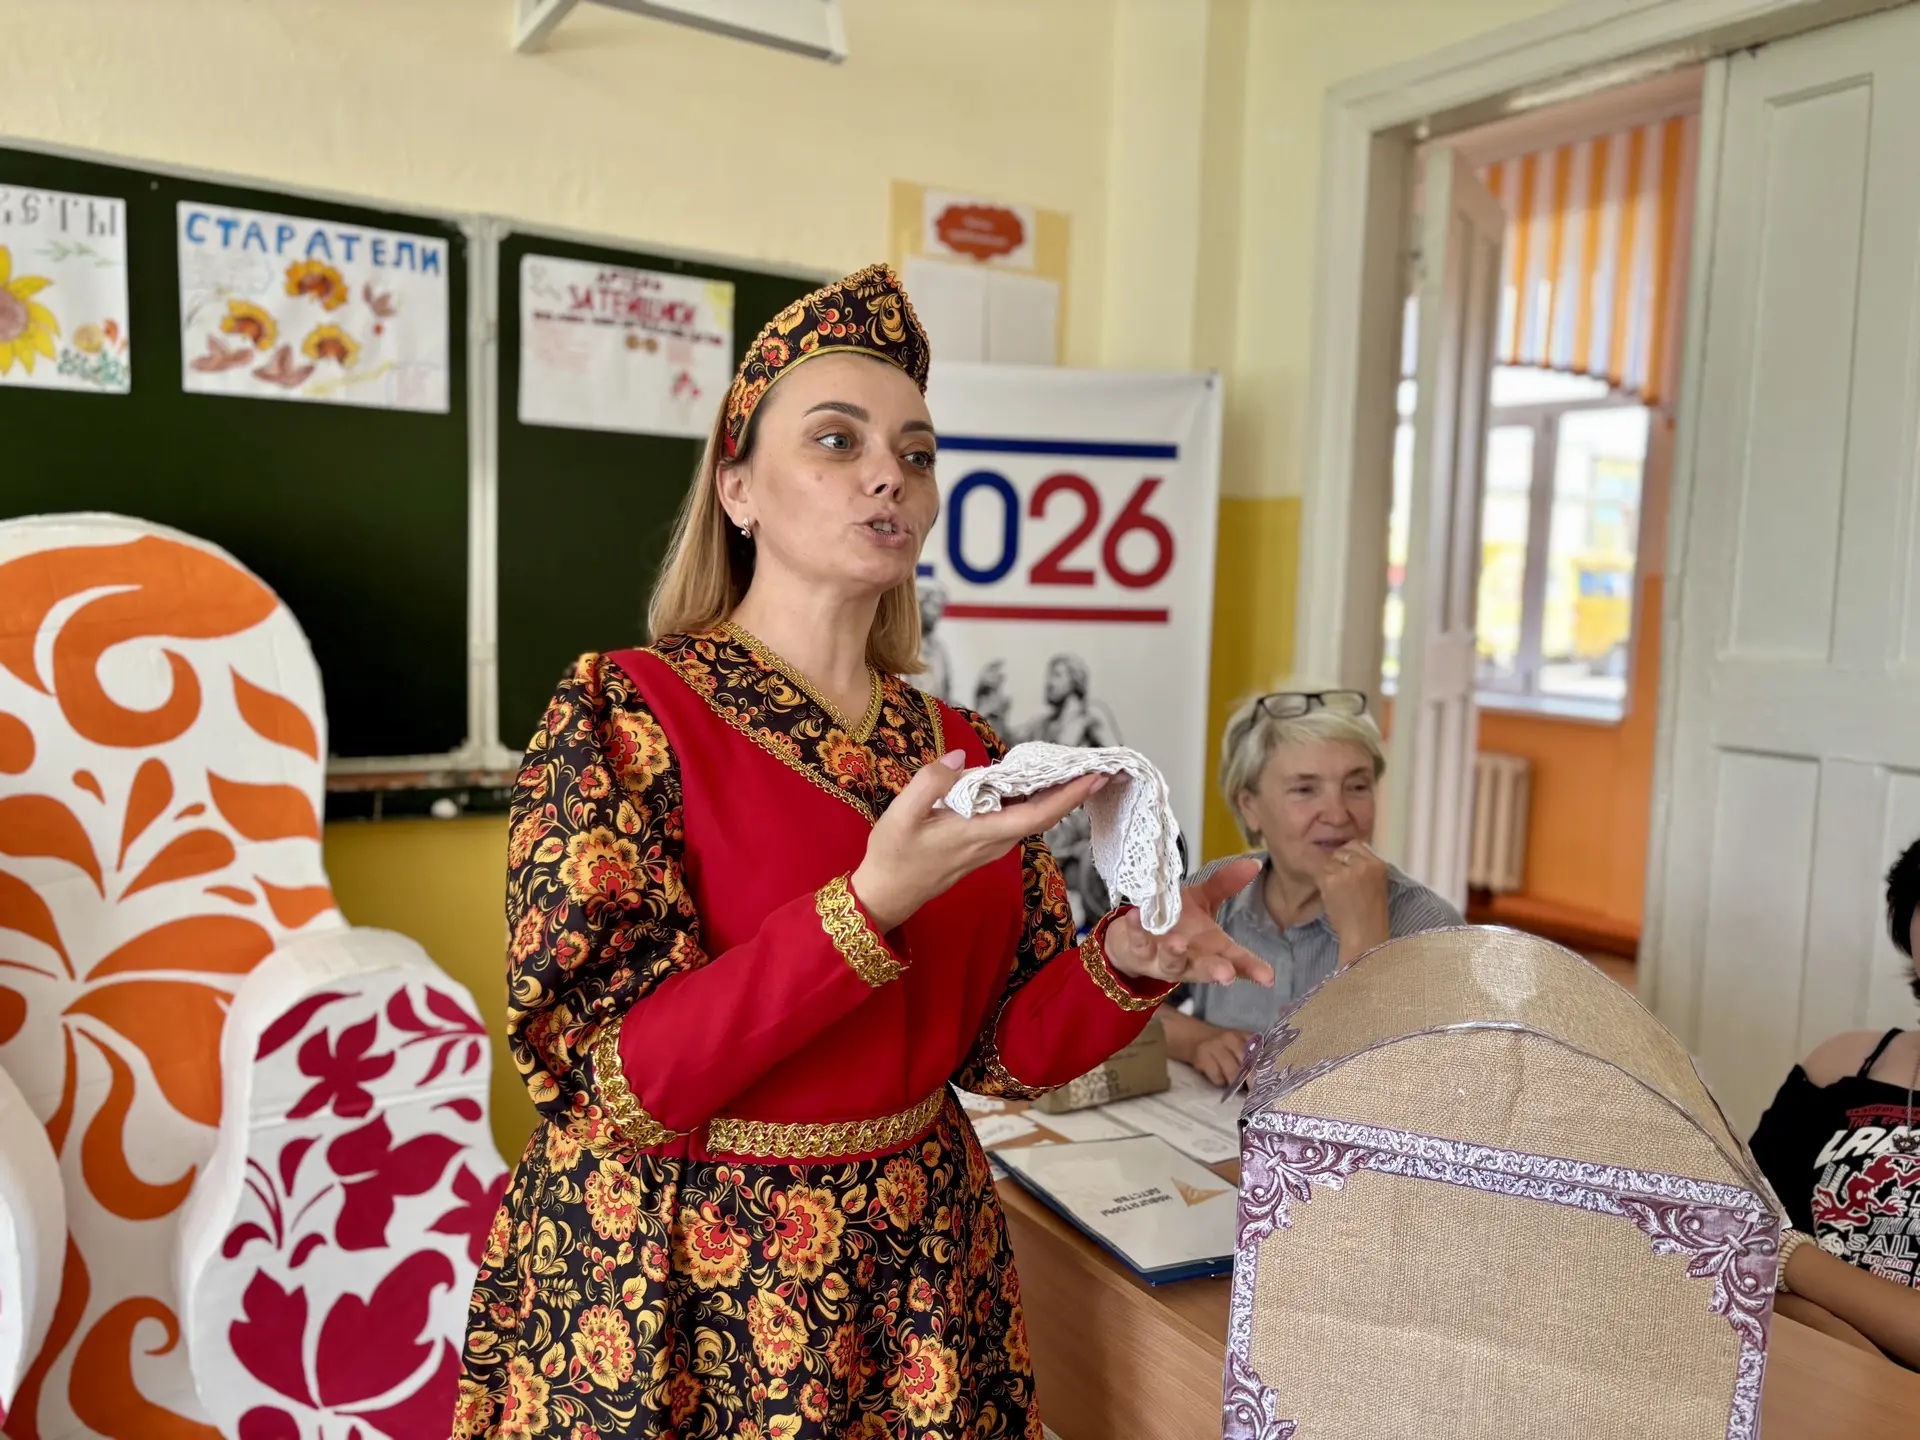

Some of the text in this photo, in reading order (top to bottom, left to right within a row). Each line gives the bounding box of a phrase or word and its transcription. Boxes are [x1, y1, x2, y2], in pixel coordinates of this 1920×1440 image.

[185, 211, 441, 277] СТАРАТЕЛИ
[917, 469, 1176, 589] 026
[1883, 1255, 1914, 1272] chen
